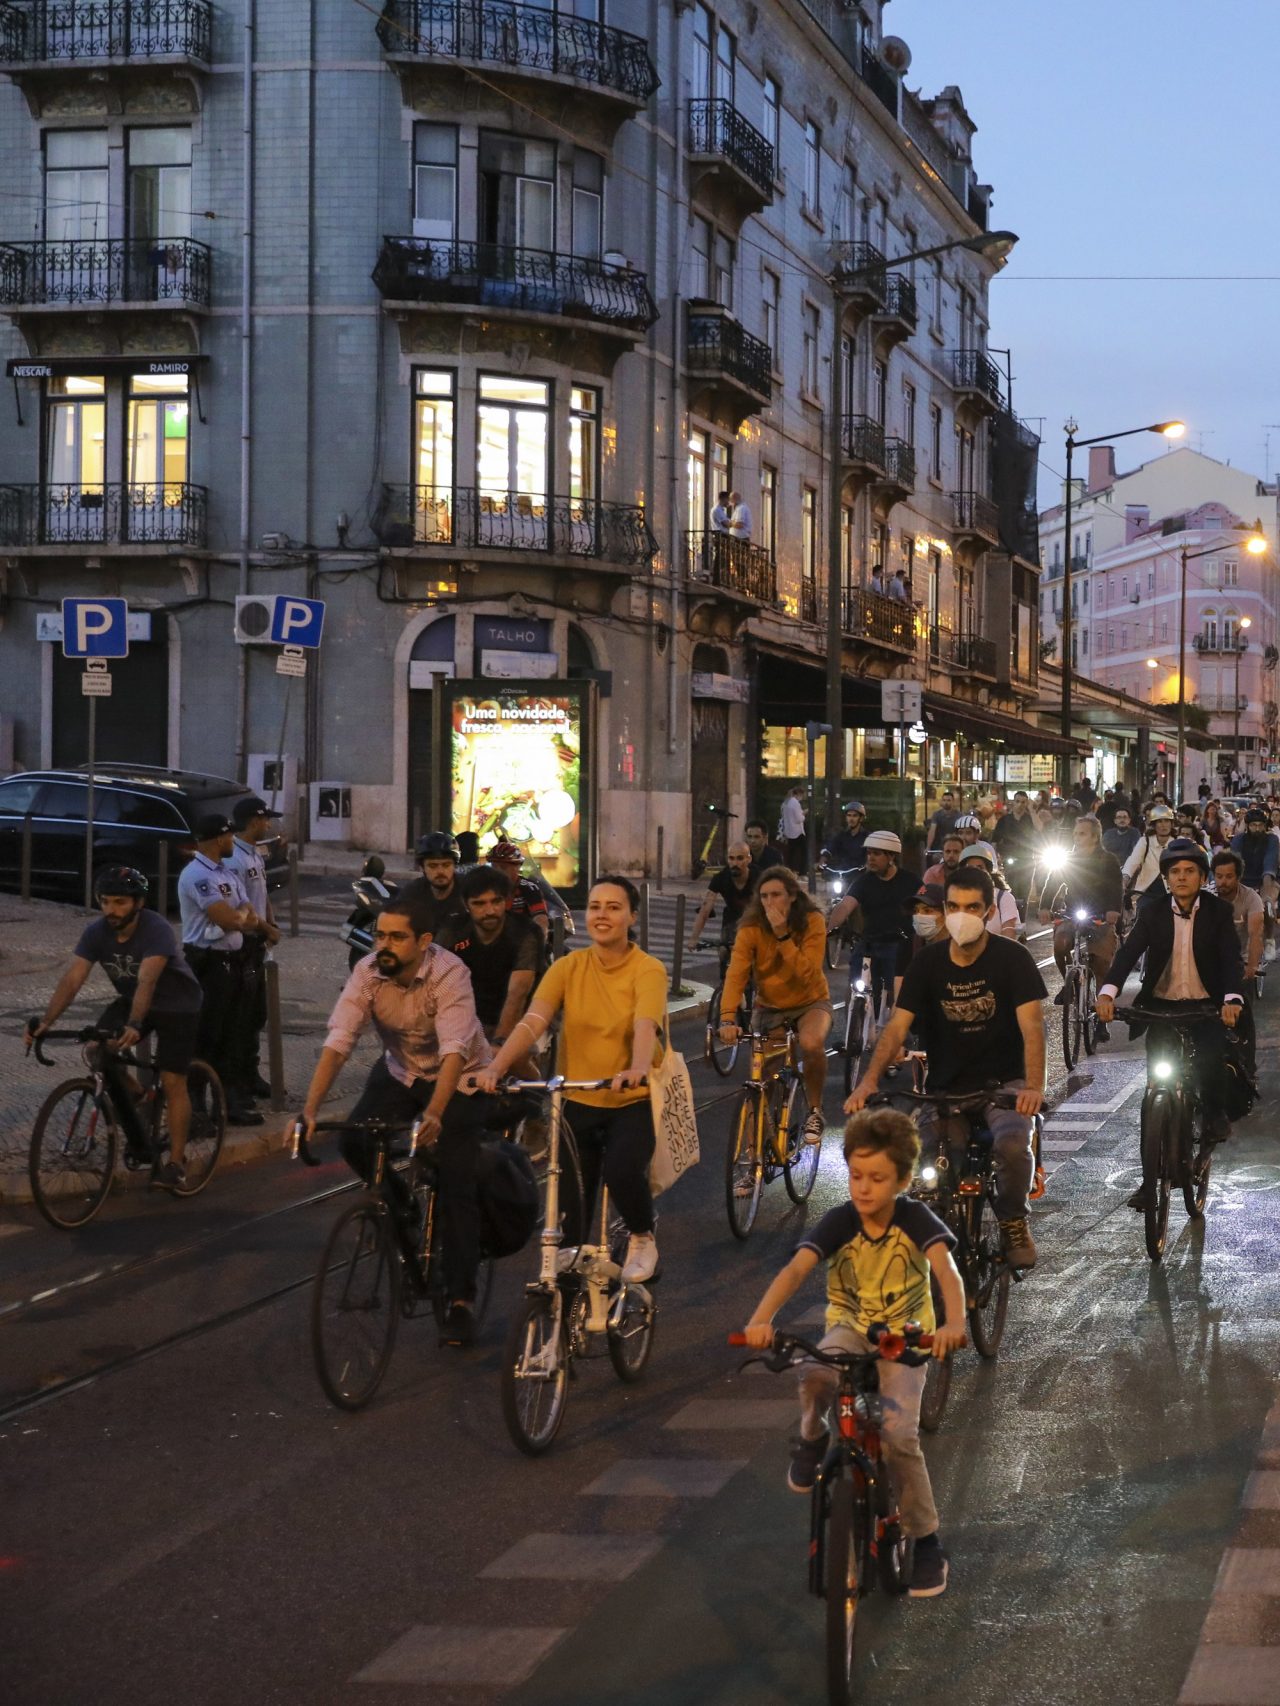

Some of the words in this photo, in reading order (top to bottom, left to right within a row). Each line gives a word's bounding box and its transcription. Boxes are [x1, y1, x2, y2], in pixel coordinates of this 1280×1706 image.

[150, 363, 189, 373] RAMIRO
[77, 604, 113, 651] P
[281, 601, 313, 639] P
[488, 628, 536, 643] TALHO
[465, 704, 497, 719] Uma
[502, 704, 565, 719] novidade
